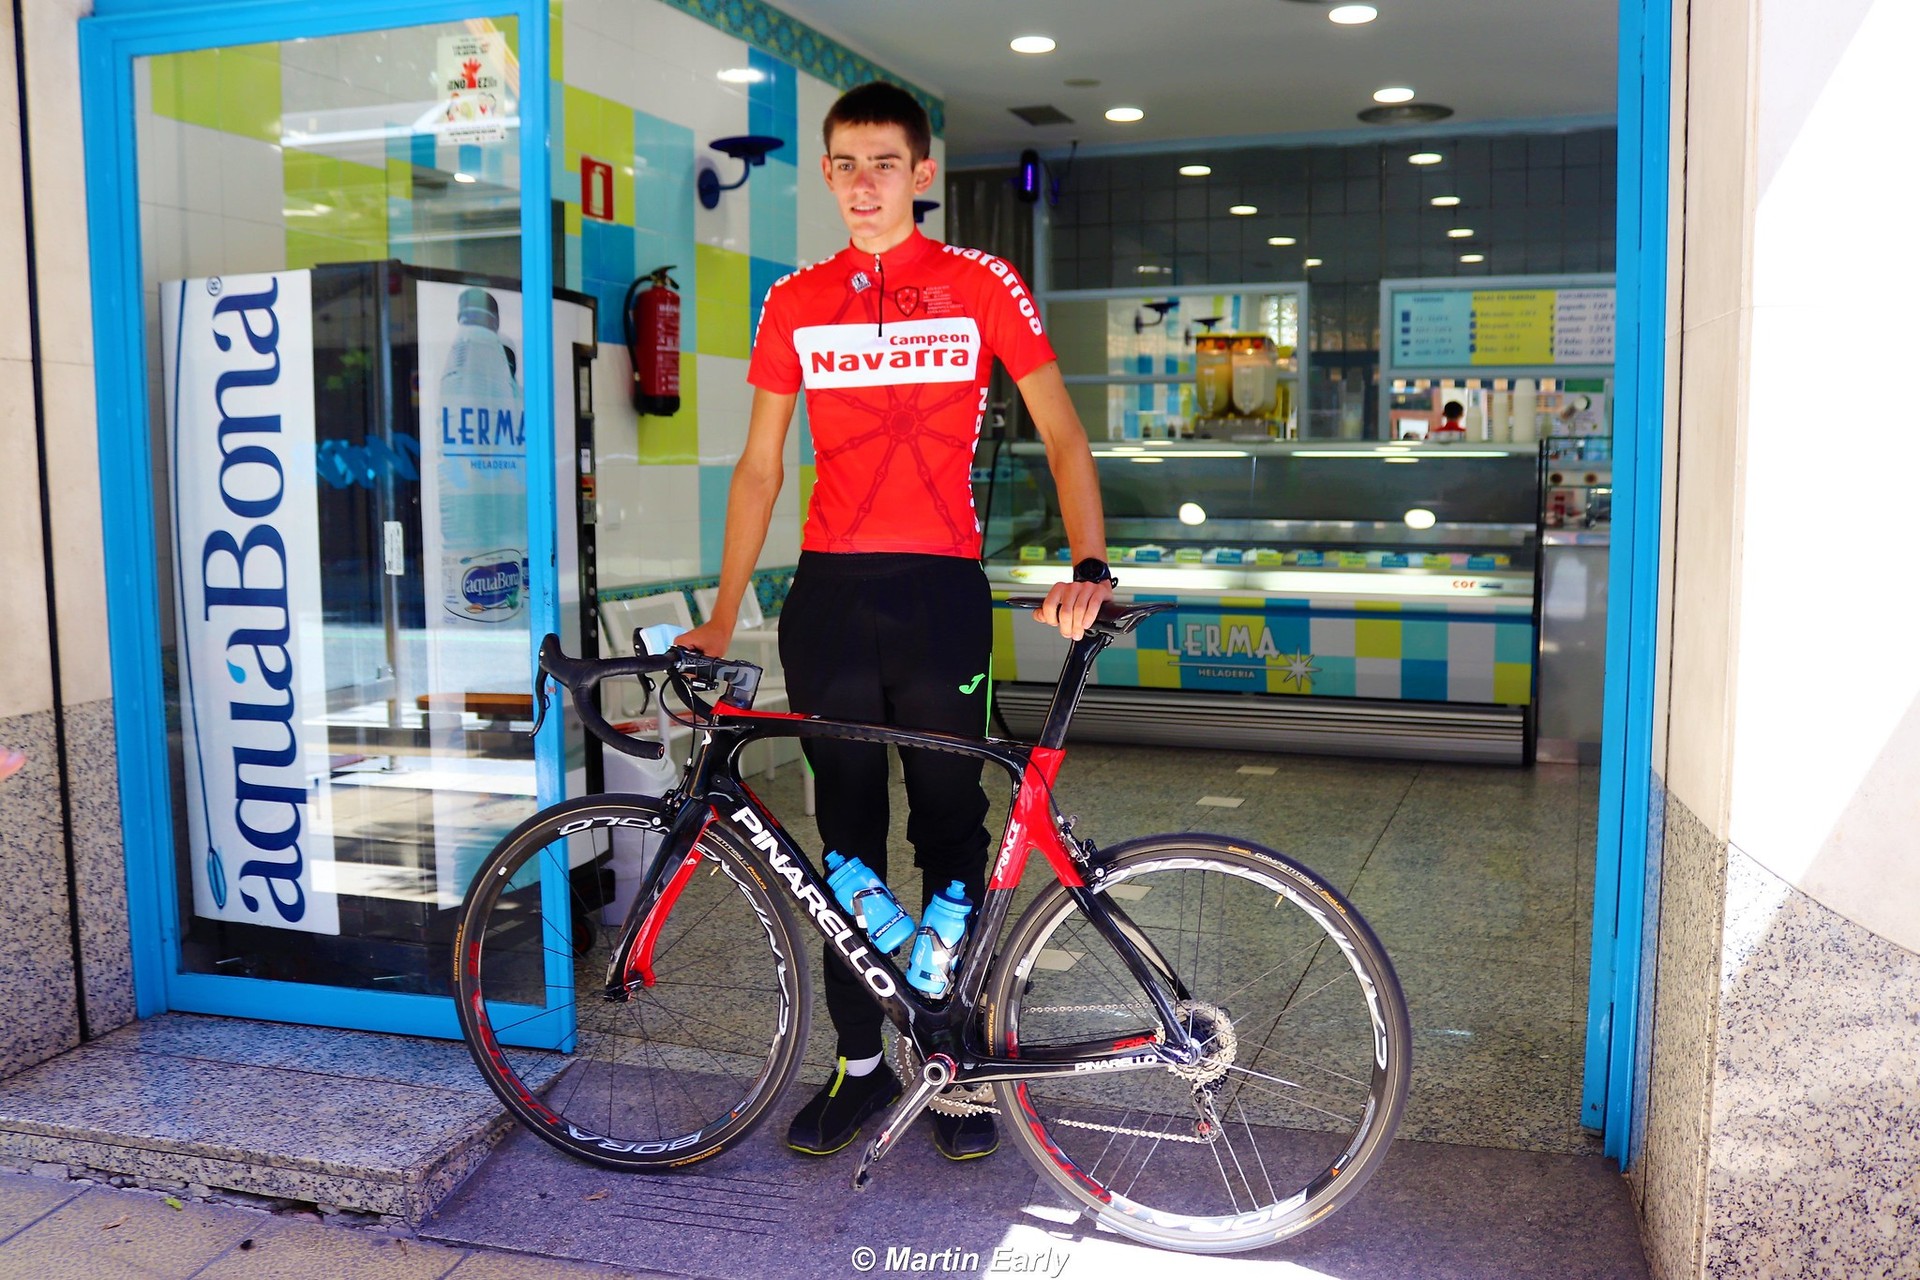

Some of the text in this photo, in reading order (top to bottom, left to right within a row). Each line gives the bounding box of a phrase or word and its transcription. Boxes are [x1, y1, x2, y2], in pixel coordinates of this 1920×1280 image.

[889, 334, 970, 346] Campeon
[811, 348, 970, 374] Navarra
[203, 276, 307, 923] aquaBona
[1166, 623, 1280, 659] LERMA
[995, 818, 1021, 882] PRINCE
[730, 806, 896, 998] PINARELLO
[1075, 1054, 1157, 1072] PINARELLO
